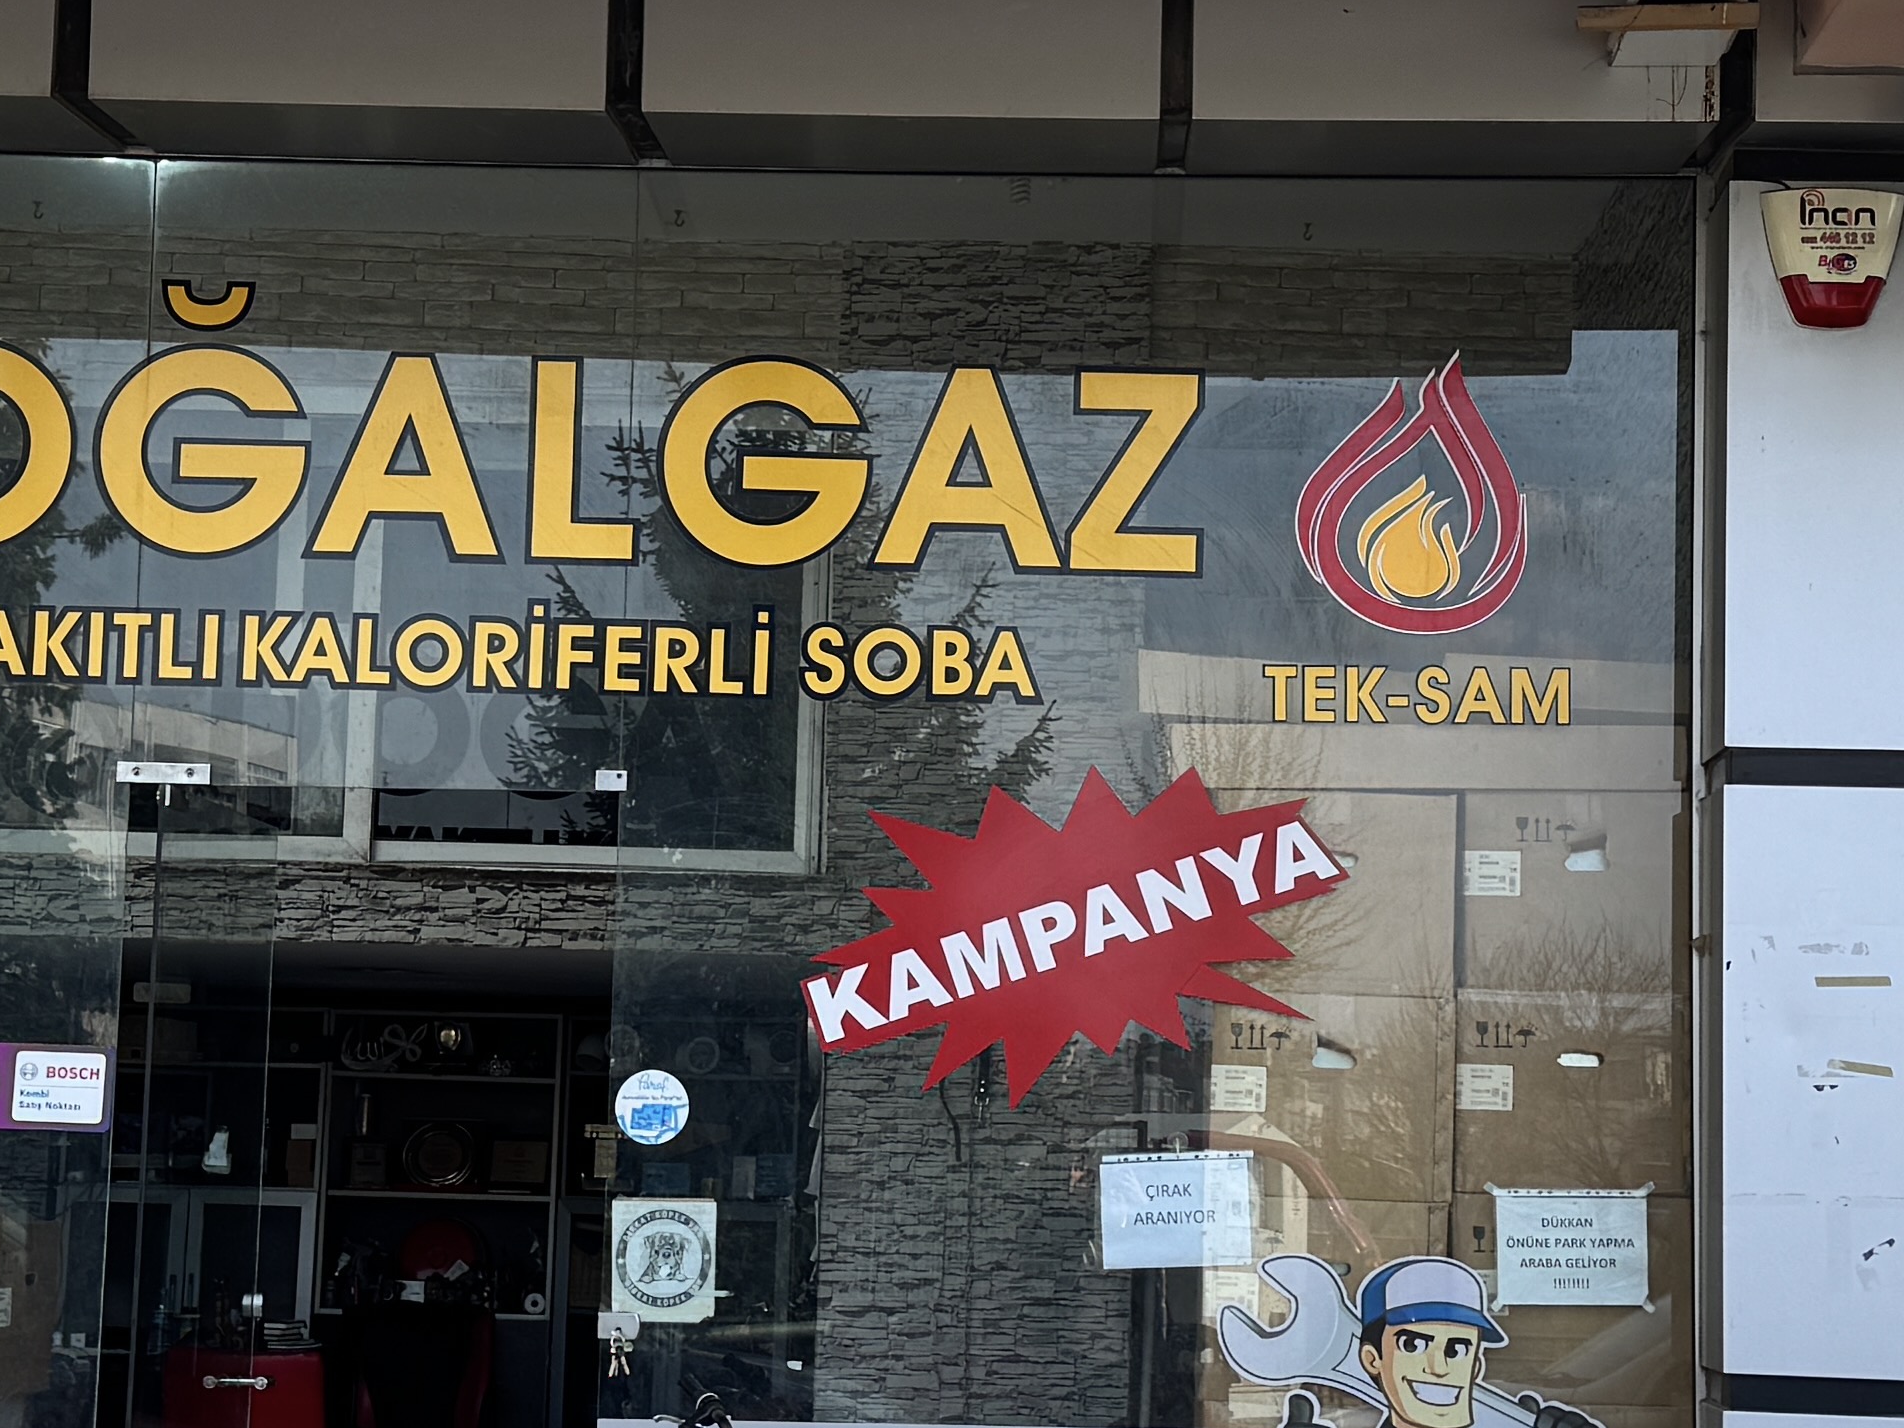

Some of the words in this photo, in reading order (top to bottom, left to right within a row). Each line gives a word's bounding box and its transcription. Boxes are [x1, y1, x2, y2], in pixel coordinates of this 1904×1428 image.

[237, 596, 775, 698] KALORİFERLİ
[799, 622, 1045, 705] SOBA
[1263, 662, 1572, 727] TEK-SAM
[804, 821, 1342, 1043] KAMPANYA
[46, 1066, 100, 1080] BOSCH
[1145, 1183, 1192, 1201] ÇIRAK
[1133, 1209, 1216, 1226] ARANIYOR
[1541, 1216, 1593, 1228] DÜKKAN
[1506, 1236, 1551, 1249] ÖNÜNE
[1554, 1238, 1586, 1249] PARK
[1589, 1239, 1635, 1249] YAPMA
[1520, 1258, 1562, 1268] ARABA
[1565, 1255, 1617, 1268] GELİYOR
